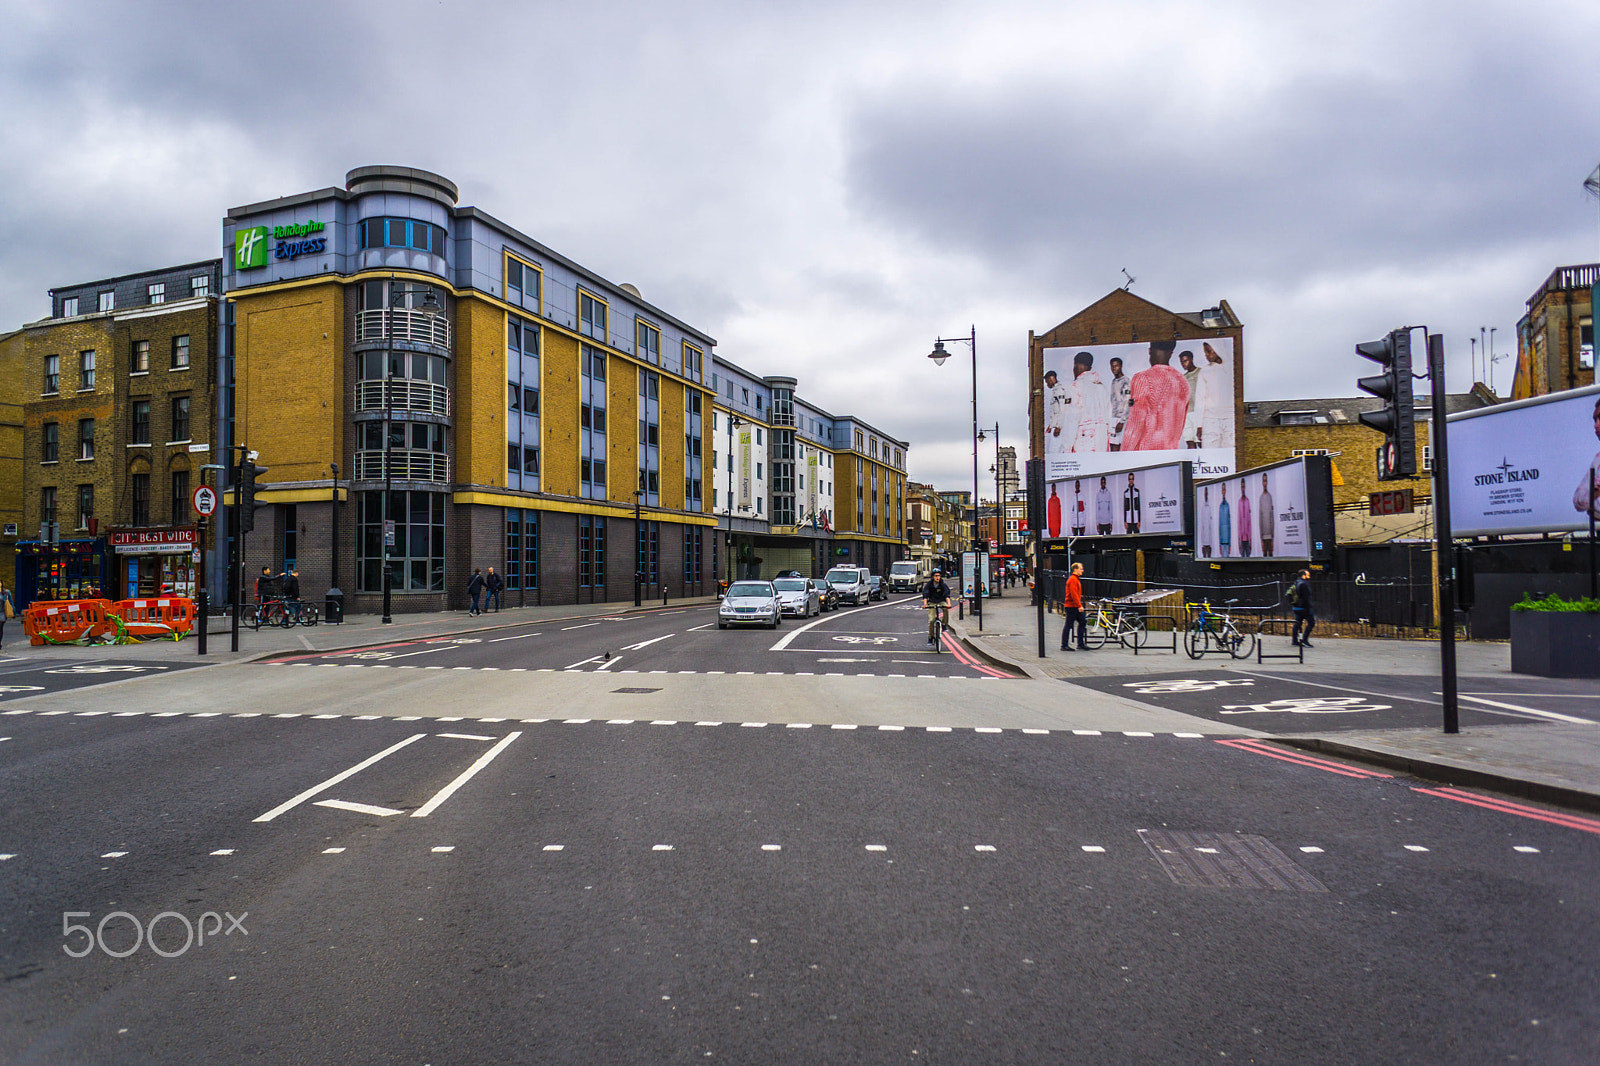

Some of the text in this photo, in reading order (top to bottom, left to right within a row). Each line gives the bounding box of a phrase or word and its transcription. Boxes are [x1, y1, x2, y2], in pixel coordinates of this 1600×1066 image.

[273, 219, 324, 239] Holiday Inn
[274, 238, 327, 260] Express
[1201, 466, 1229, 474] ISLAND
[1474, 468, 1539, 486] STONE ISLAND
[1371, 491, 1404, 514] RED
[140, 531, 163, 543] BEST
[167, 530, 192, 541] WINE
